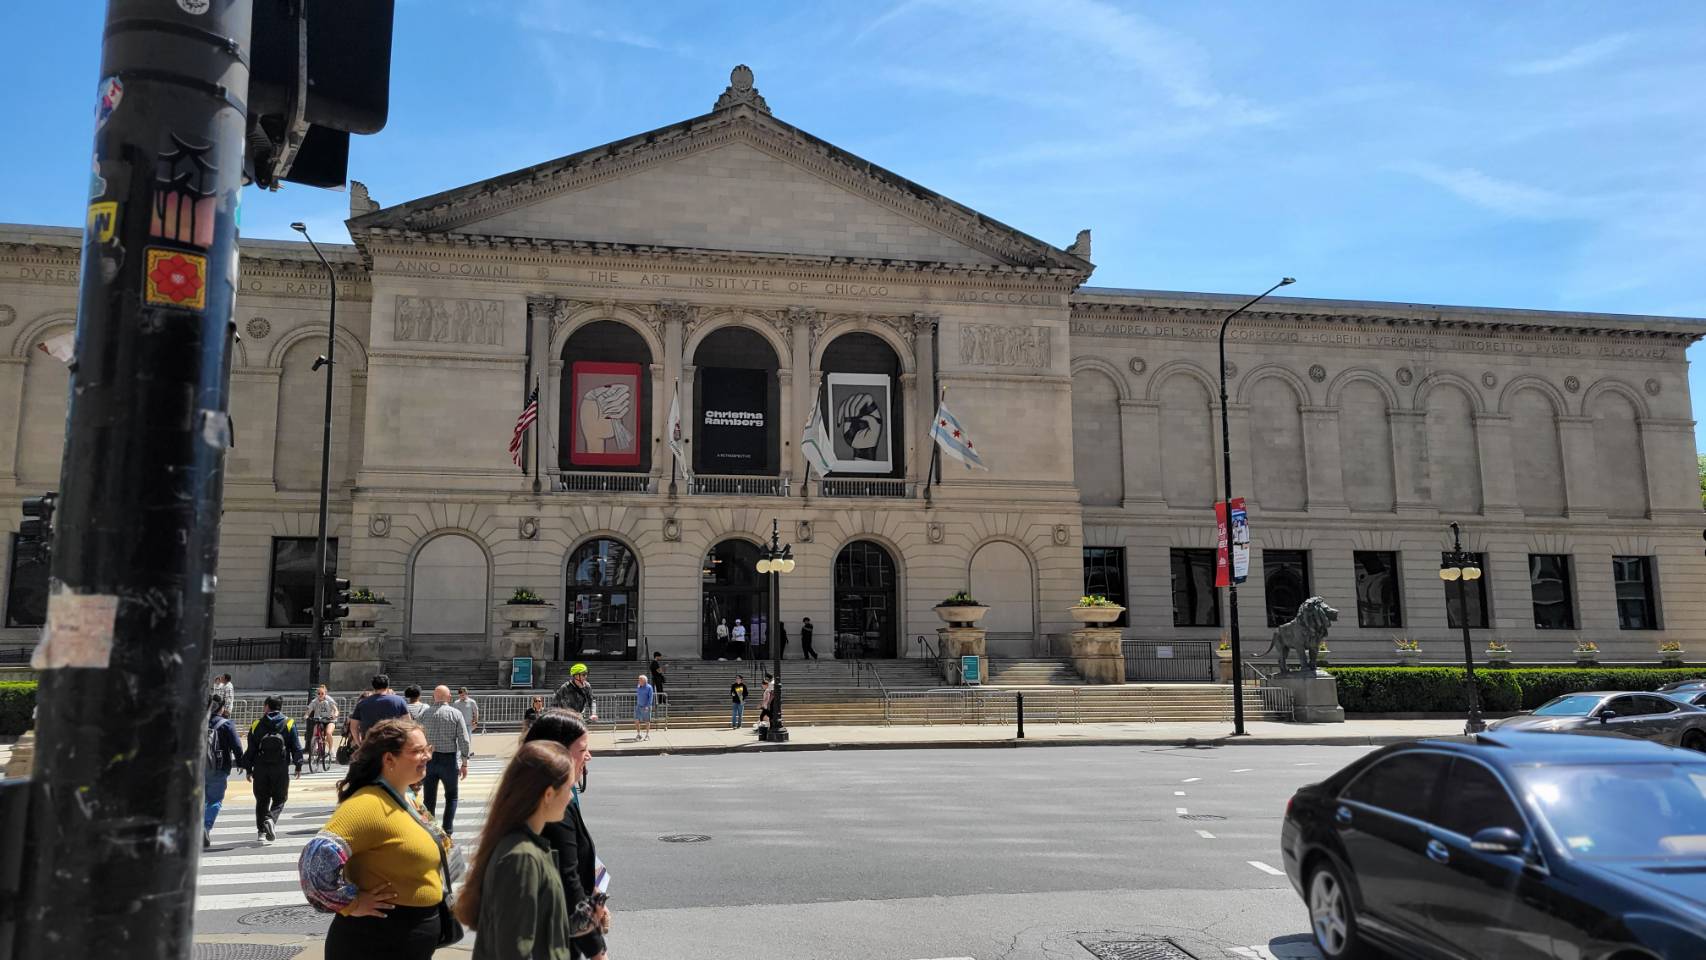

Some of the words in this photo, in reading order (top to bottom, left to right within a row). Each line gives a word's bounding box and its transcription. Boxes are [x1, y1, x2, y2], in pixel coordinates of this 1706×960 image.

[394, 260, 441, 274] ANNO
[448, 263, 509, 277] DOMINI
[588, 270, 620, 284] THE
[640, 273, 670, 287] ART
[688, 277, 770, 292] INSTITVTE
[788, 281, 808, 294] OF
[825, 284, 889, 298] CHICAGO
[1104, 324, 1148, 336] ANDREA
[1182, 327, 1219, 338] SARTO
[1312, 334, 1361, 345] HOLBEIN
[705, 410, 763, 419] Christina
